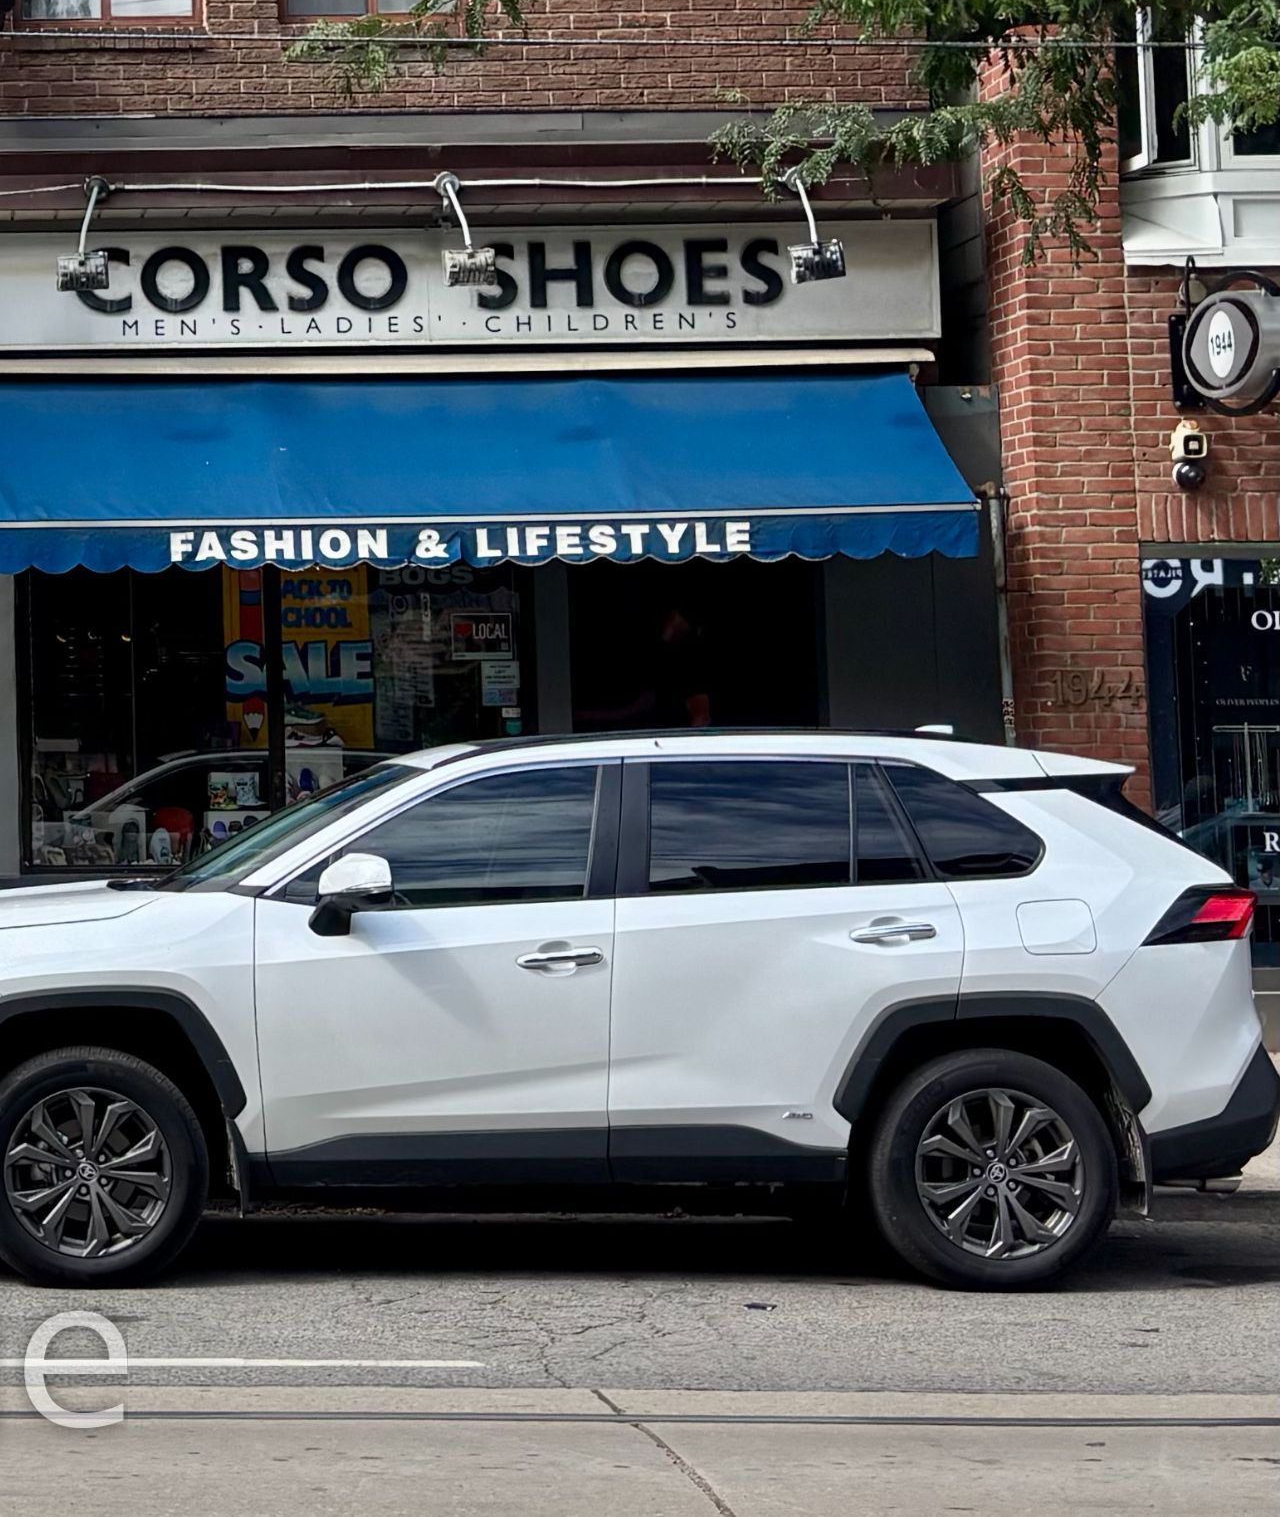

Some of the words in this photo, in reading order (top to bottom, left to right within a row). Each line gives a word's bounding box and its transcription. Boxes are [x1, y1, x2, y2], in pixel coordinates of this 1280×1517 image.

[76, 243, 408, 314] CORSO
[477, 237, 785, 311] SHOES
[122, 318, 241, 337] MEN'S
[281, 315, 442, 334] LADIES'
[485, 312, 737, 333] CHILDREN'S
[1210, 331, 1233, 356] 1944
[170, 527, 388, 562] FASHION
[416, 528, 449, 558] &
[476, 522, 752, 559] LIFESTYLE
[379, 565, 475, 585] BOGS
[282, 578, 321, 600] ACK
[281, 606, 352, 628] CHOOL
[472, 623, 509, 639] LOCAL
[225, 640, 373, 696] SALE
[1051, 669, 1145, 707] 1944
